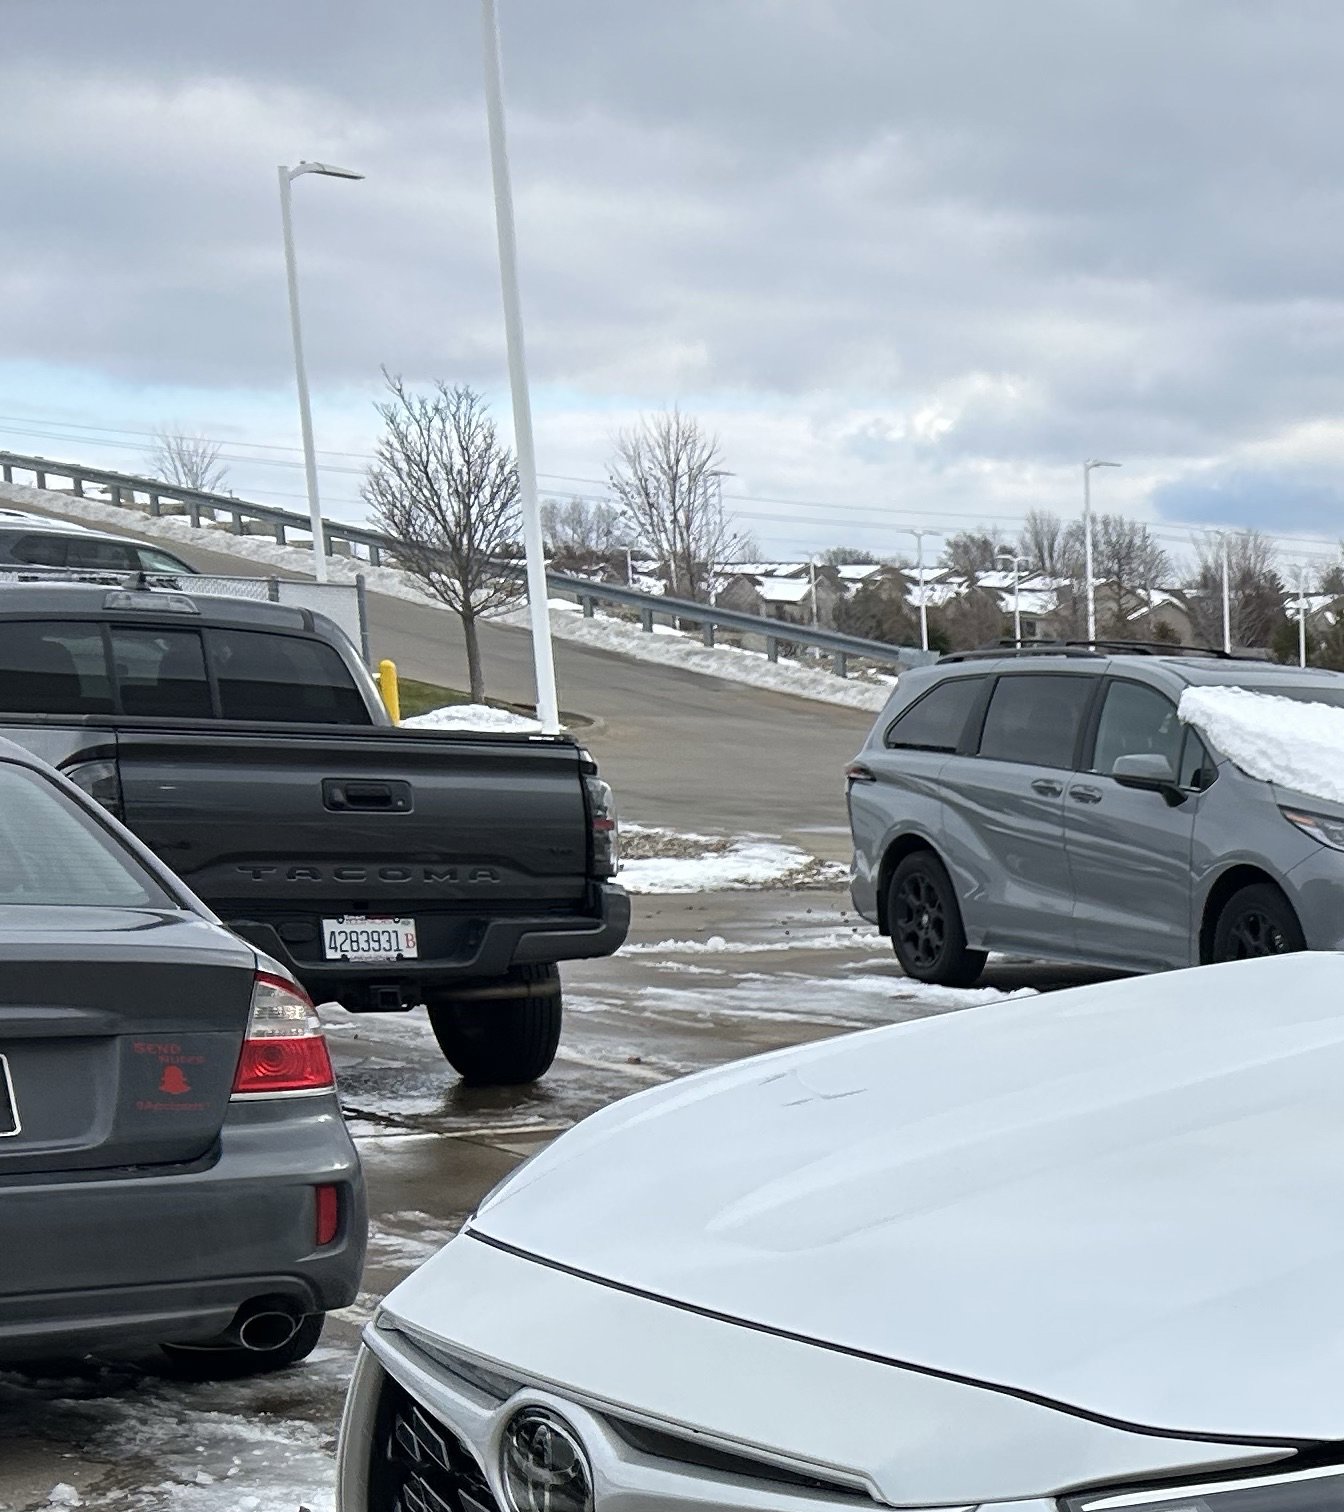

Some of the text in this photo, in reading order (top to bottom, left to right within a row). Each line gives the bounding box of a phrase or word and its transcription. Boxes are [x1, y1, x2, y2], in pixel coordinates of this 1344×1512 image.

[236, 865, 501, 883] TACOMA
[328, 930, 416, 953] 4283931 B
